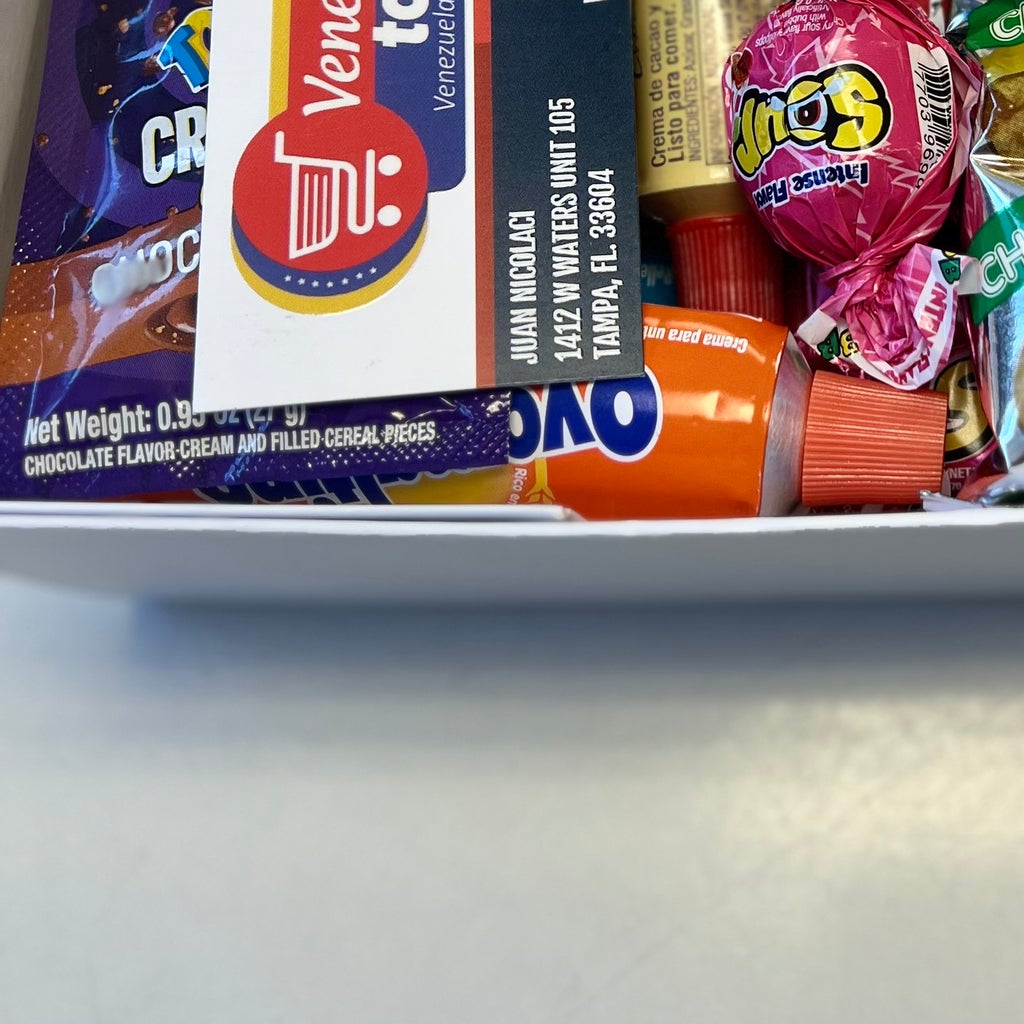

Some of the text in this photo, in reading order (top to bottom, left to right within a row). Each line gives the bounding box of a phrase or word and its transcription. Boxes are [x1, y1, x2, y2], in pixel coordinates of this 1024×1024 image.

[648, 4, 663, 17] y
[648, 18, 662, 74] cacao
[650, 79, 662, 104] de
[664, 3, 687, 164] Listo para comer.
[651, 107, 667, 169] Crema
[683, 74, 702, 163] INGREDIENTES:
[793, 164, 868, 194] Intense
[548, 97, 583, 362] 1412 W WATERS UNIT 105
[508, 210, 539, 365] JUAN NICOLACI
[587, 168, 624, 360] TAMPA, FL. 33604
[643, 325, 748, 354] Crema para unt
[24, 415, 61, 446] Net
[66, 404, 151, 442] Weight:
[24, 446, 114, 476] CHOCOLATE
[238, 433, 267, 455] AND
[271, 428, 321, 451] FILLED
[325, 425, 380, 446] CEREAL
[384, 421, 436, 443] PIECES
[512, 467, 528, 492] Rico
